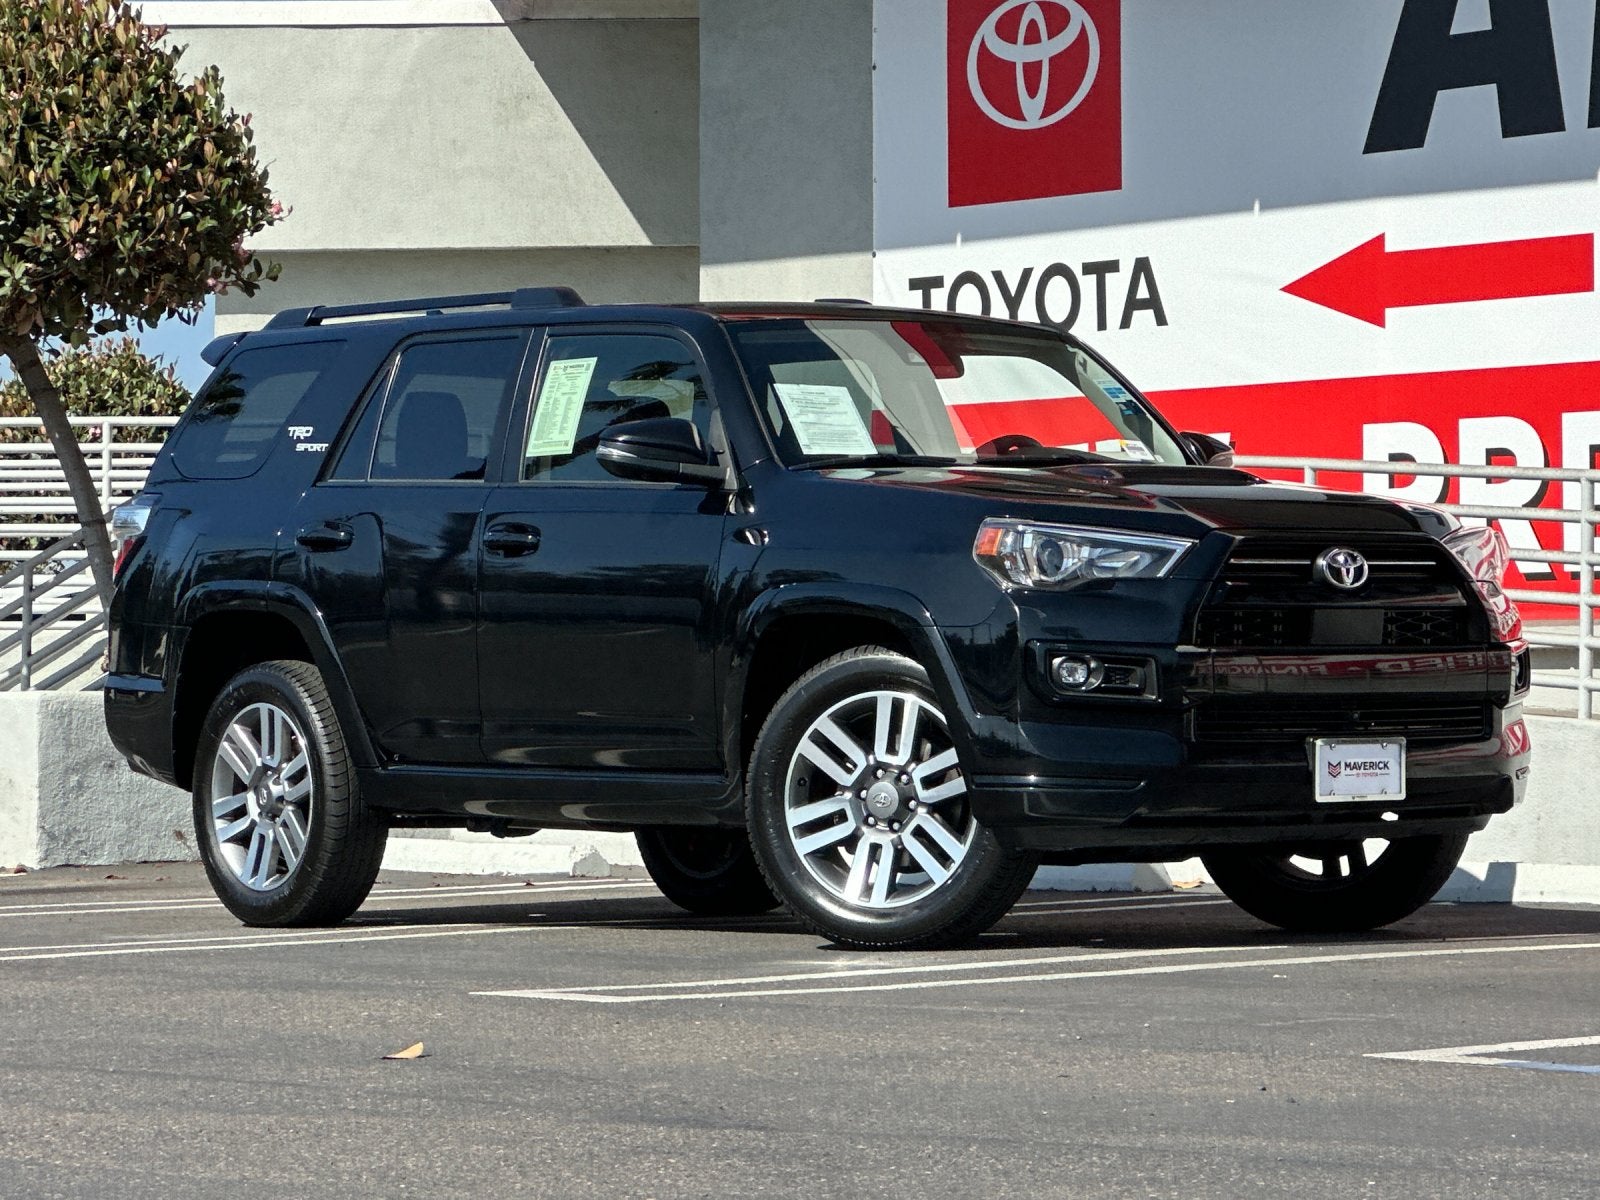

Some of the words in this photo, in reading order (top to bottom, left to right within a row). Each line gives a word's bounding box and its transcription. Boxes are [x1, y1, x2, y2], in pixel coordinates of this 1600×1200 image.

[1362, 0, 1600, 155] A
[908, 256, 1169, 331] TOYOTA
[288, 426, 314, 440] TRD
[295, 443, 329, 452] SPORT
[1344, 760, 1390, 771] MAVERICK
